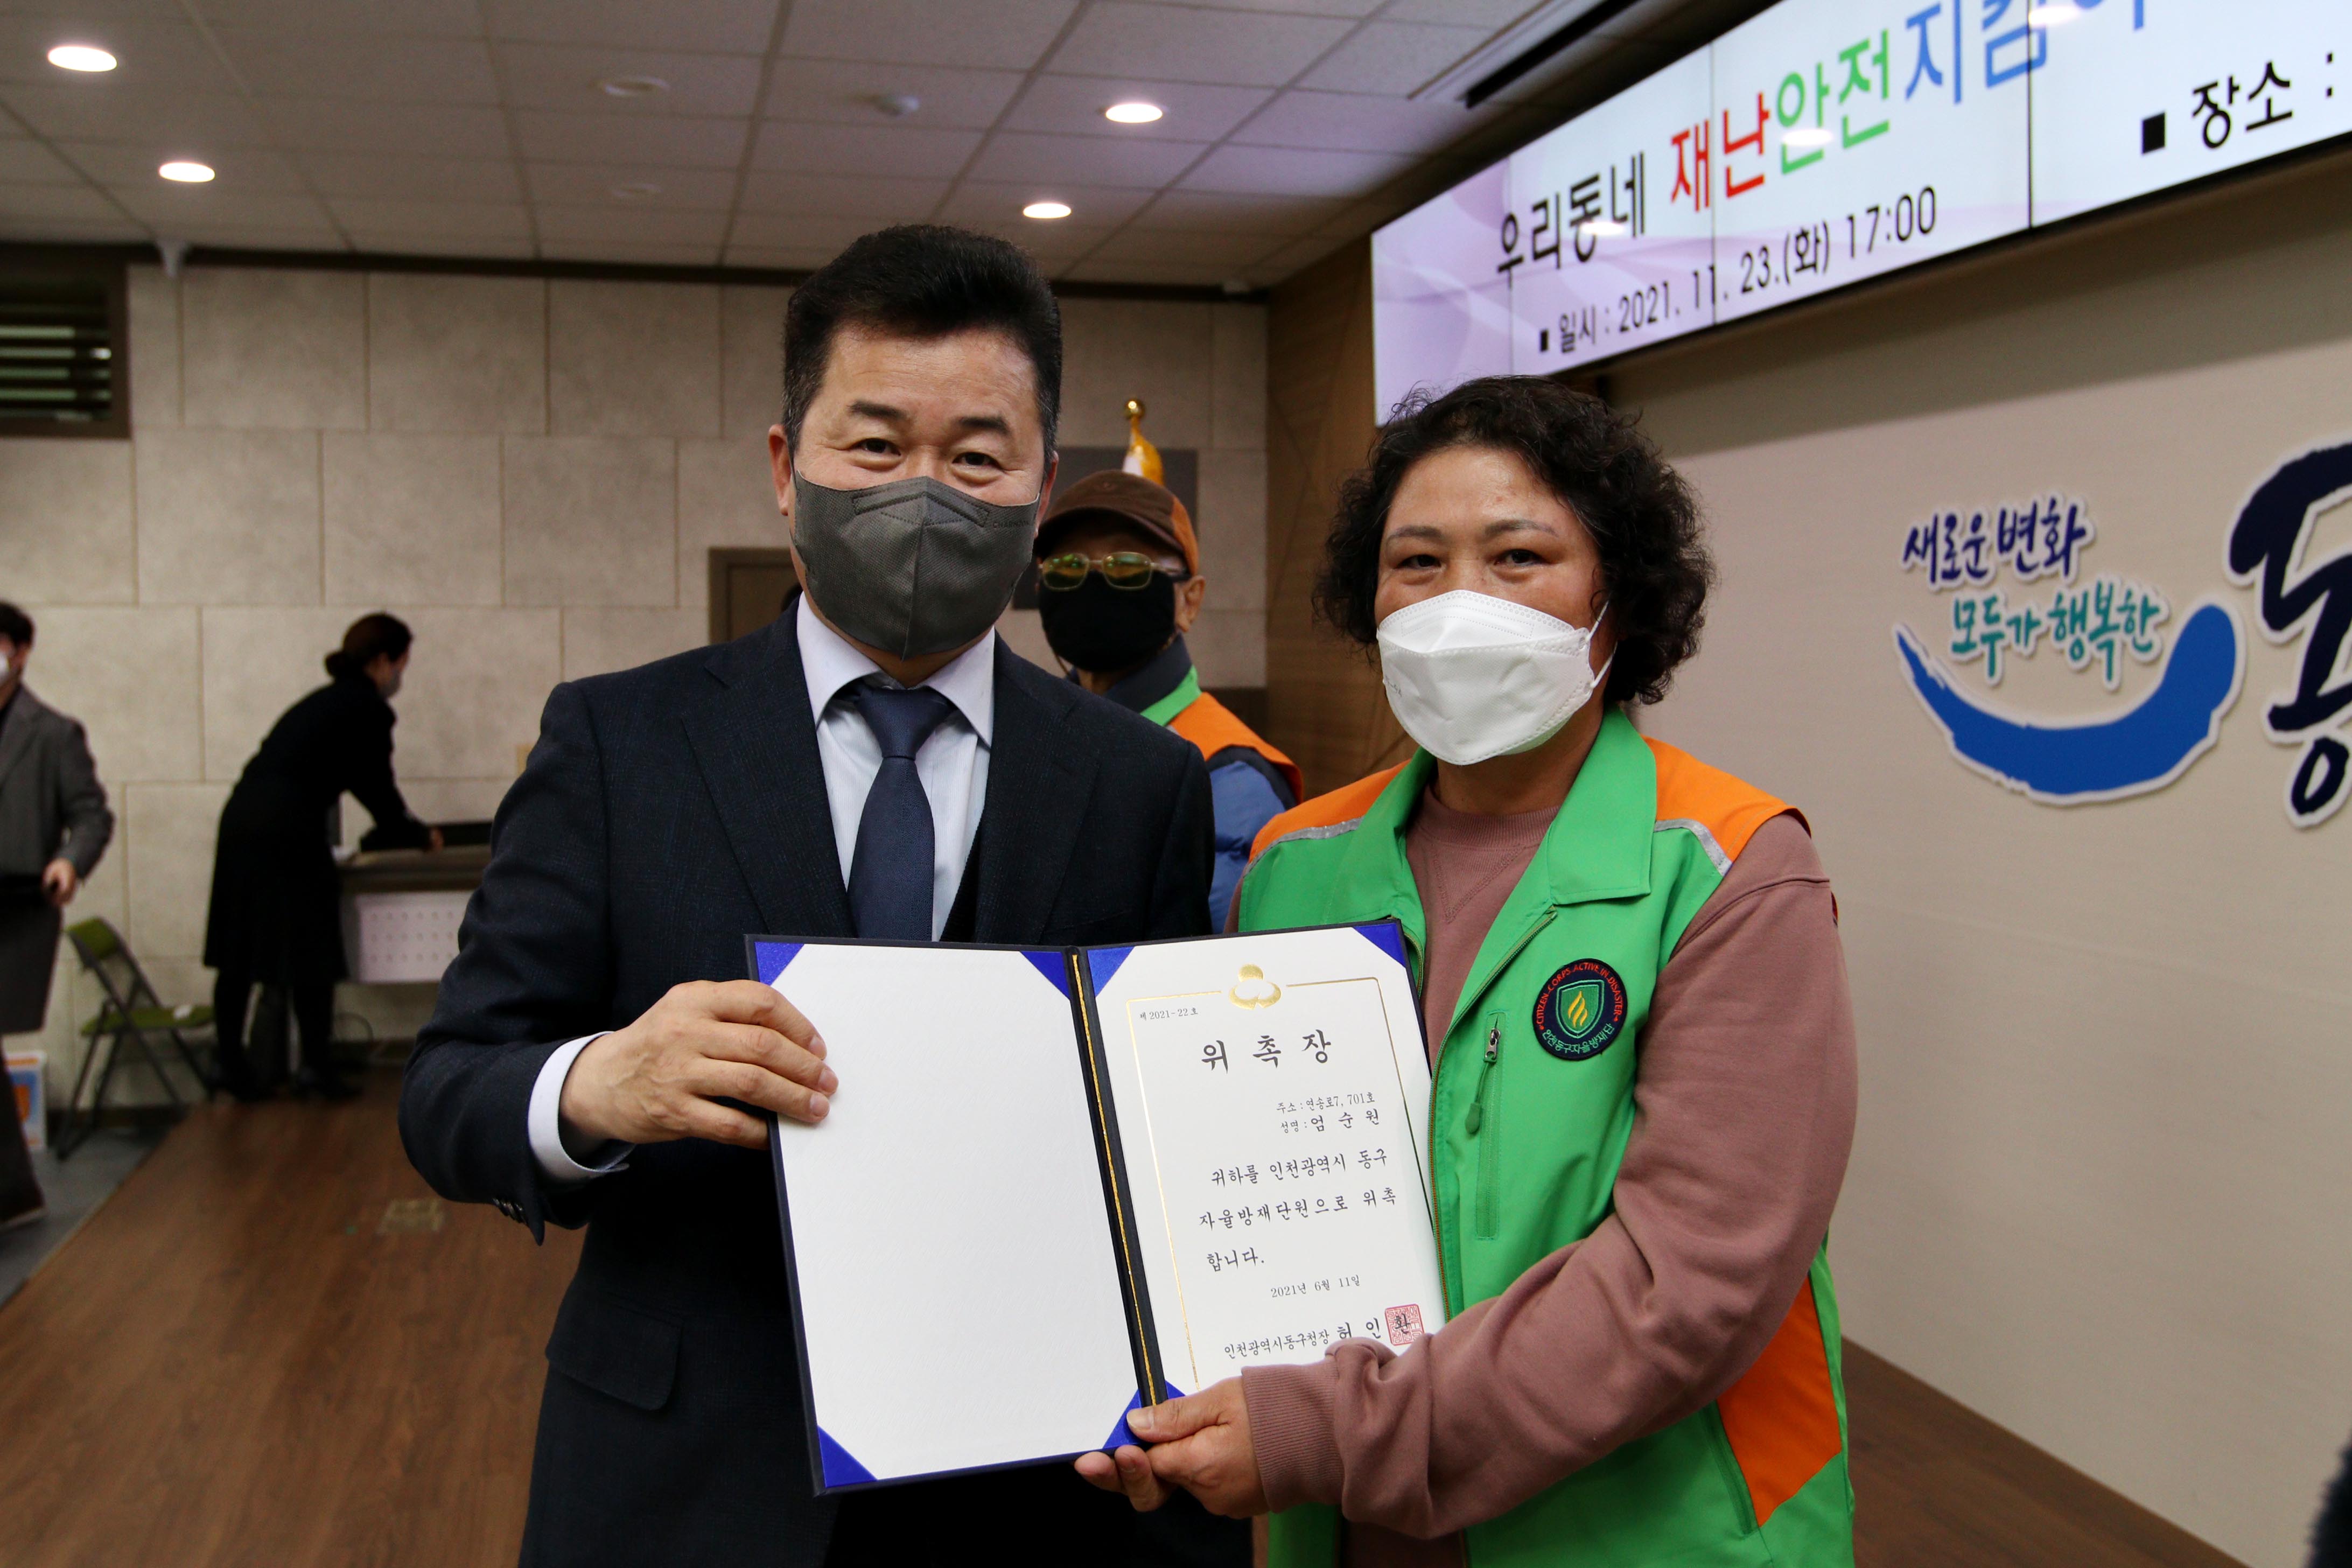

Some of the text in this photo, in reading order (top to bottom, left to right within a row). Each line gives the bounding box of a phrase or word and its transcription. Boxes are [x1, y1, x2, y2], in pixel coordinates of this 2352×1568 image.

[1497, 151, 1645, 289] 우리동네
[1559, 305, 1597, 354] 일시
[1619, 281, 1680, 334] 2021.
[1741, 219, 1830, 294] 23.(화)
[1847, 186, 1937, 259] 17:00
[2192, 61, 2293, 149] 장소
[1903, 496, 2086, 584] 새로운 변화
[1951, 581, 2160, 682] 모두가 행복한
[1536, 962, 1623, 1025] CITIZEN CORPS ACTIVE IN DISASTER
[1211, 1148, 1387, 1187] 귀하를 인천광역시 동구
[1199, 1187, 1396, 1230] 자율방재단원으로 위촉
[1207, 1247, 1264, 1272] 합니다.
[1271, 1275, 1360, 1298] 2021년 6월 11일
[1224, 1329, 1329, 1359] 인천광역시동구청장
